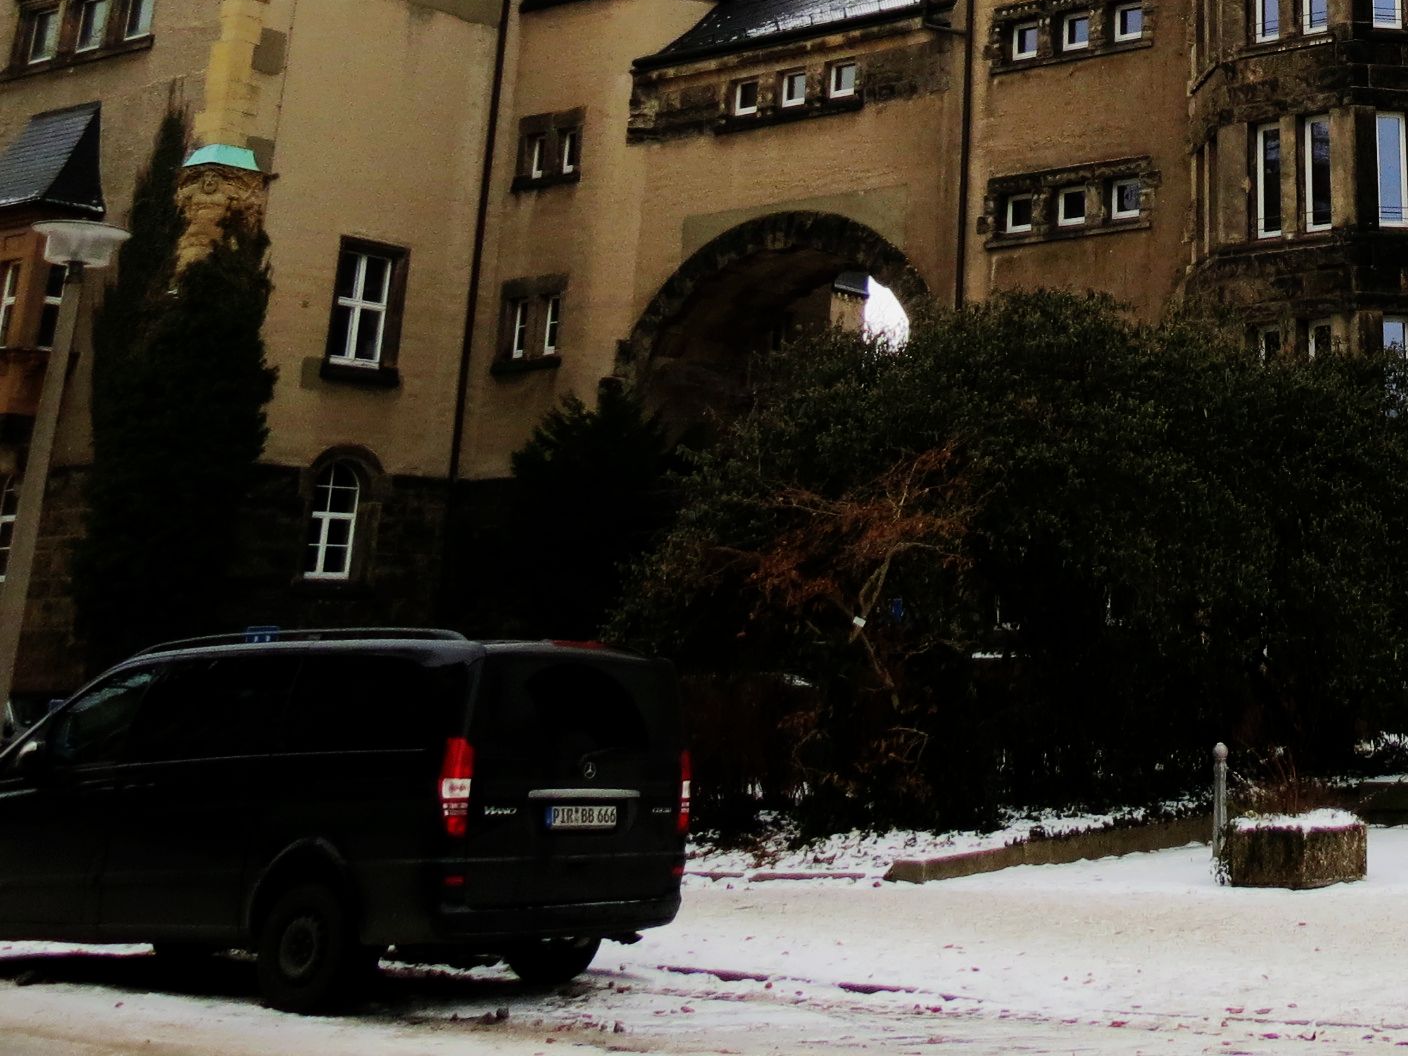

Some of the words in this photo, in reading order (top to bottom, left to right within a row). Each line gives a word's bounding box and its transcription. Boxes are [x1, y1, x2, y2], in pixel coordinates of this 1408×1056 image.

[553, 808, 574, 824] PIR
[581, 808, 595, 824] BB
[597, 808, 616, 824] 666
